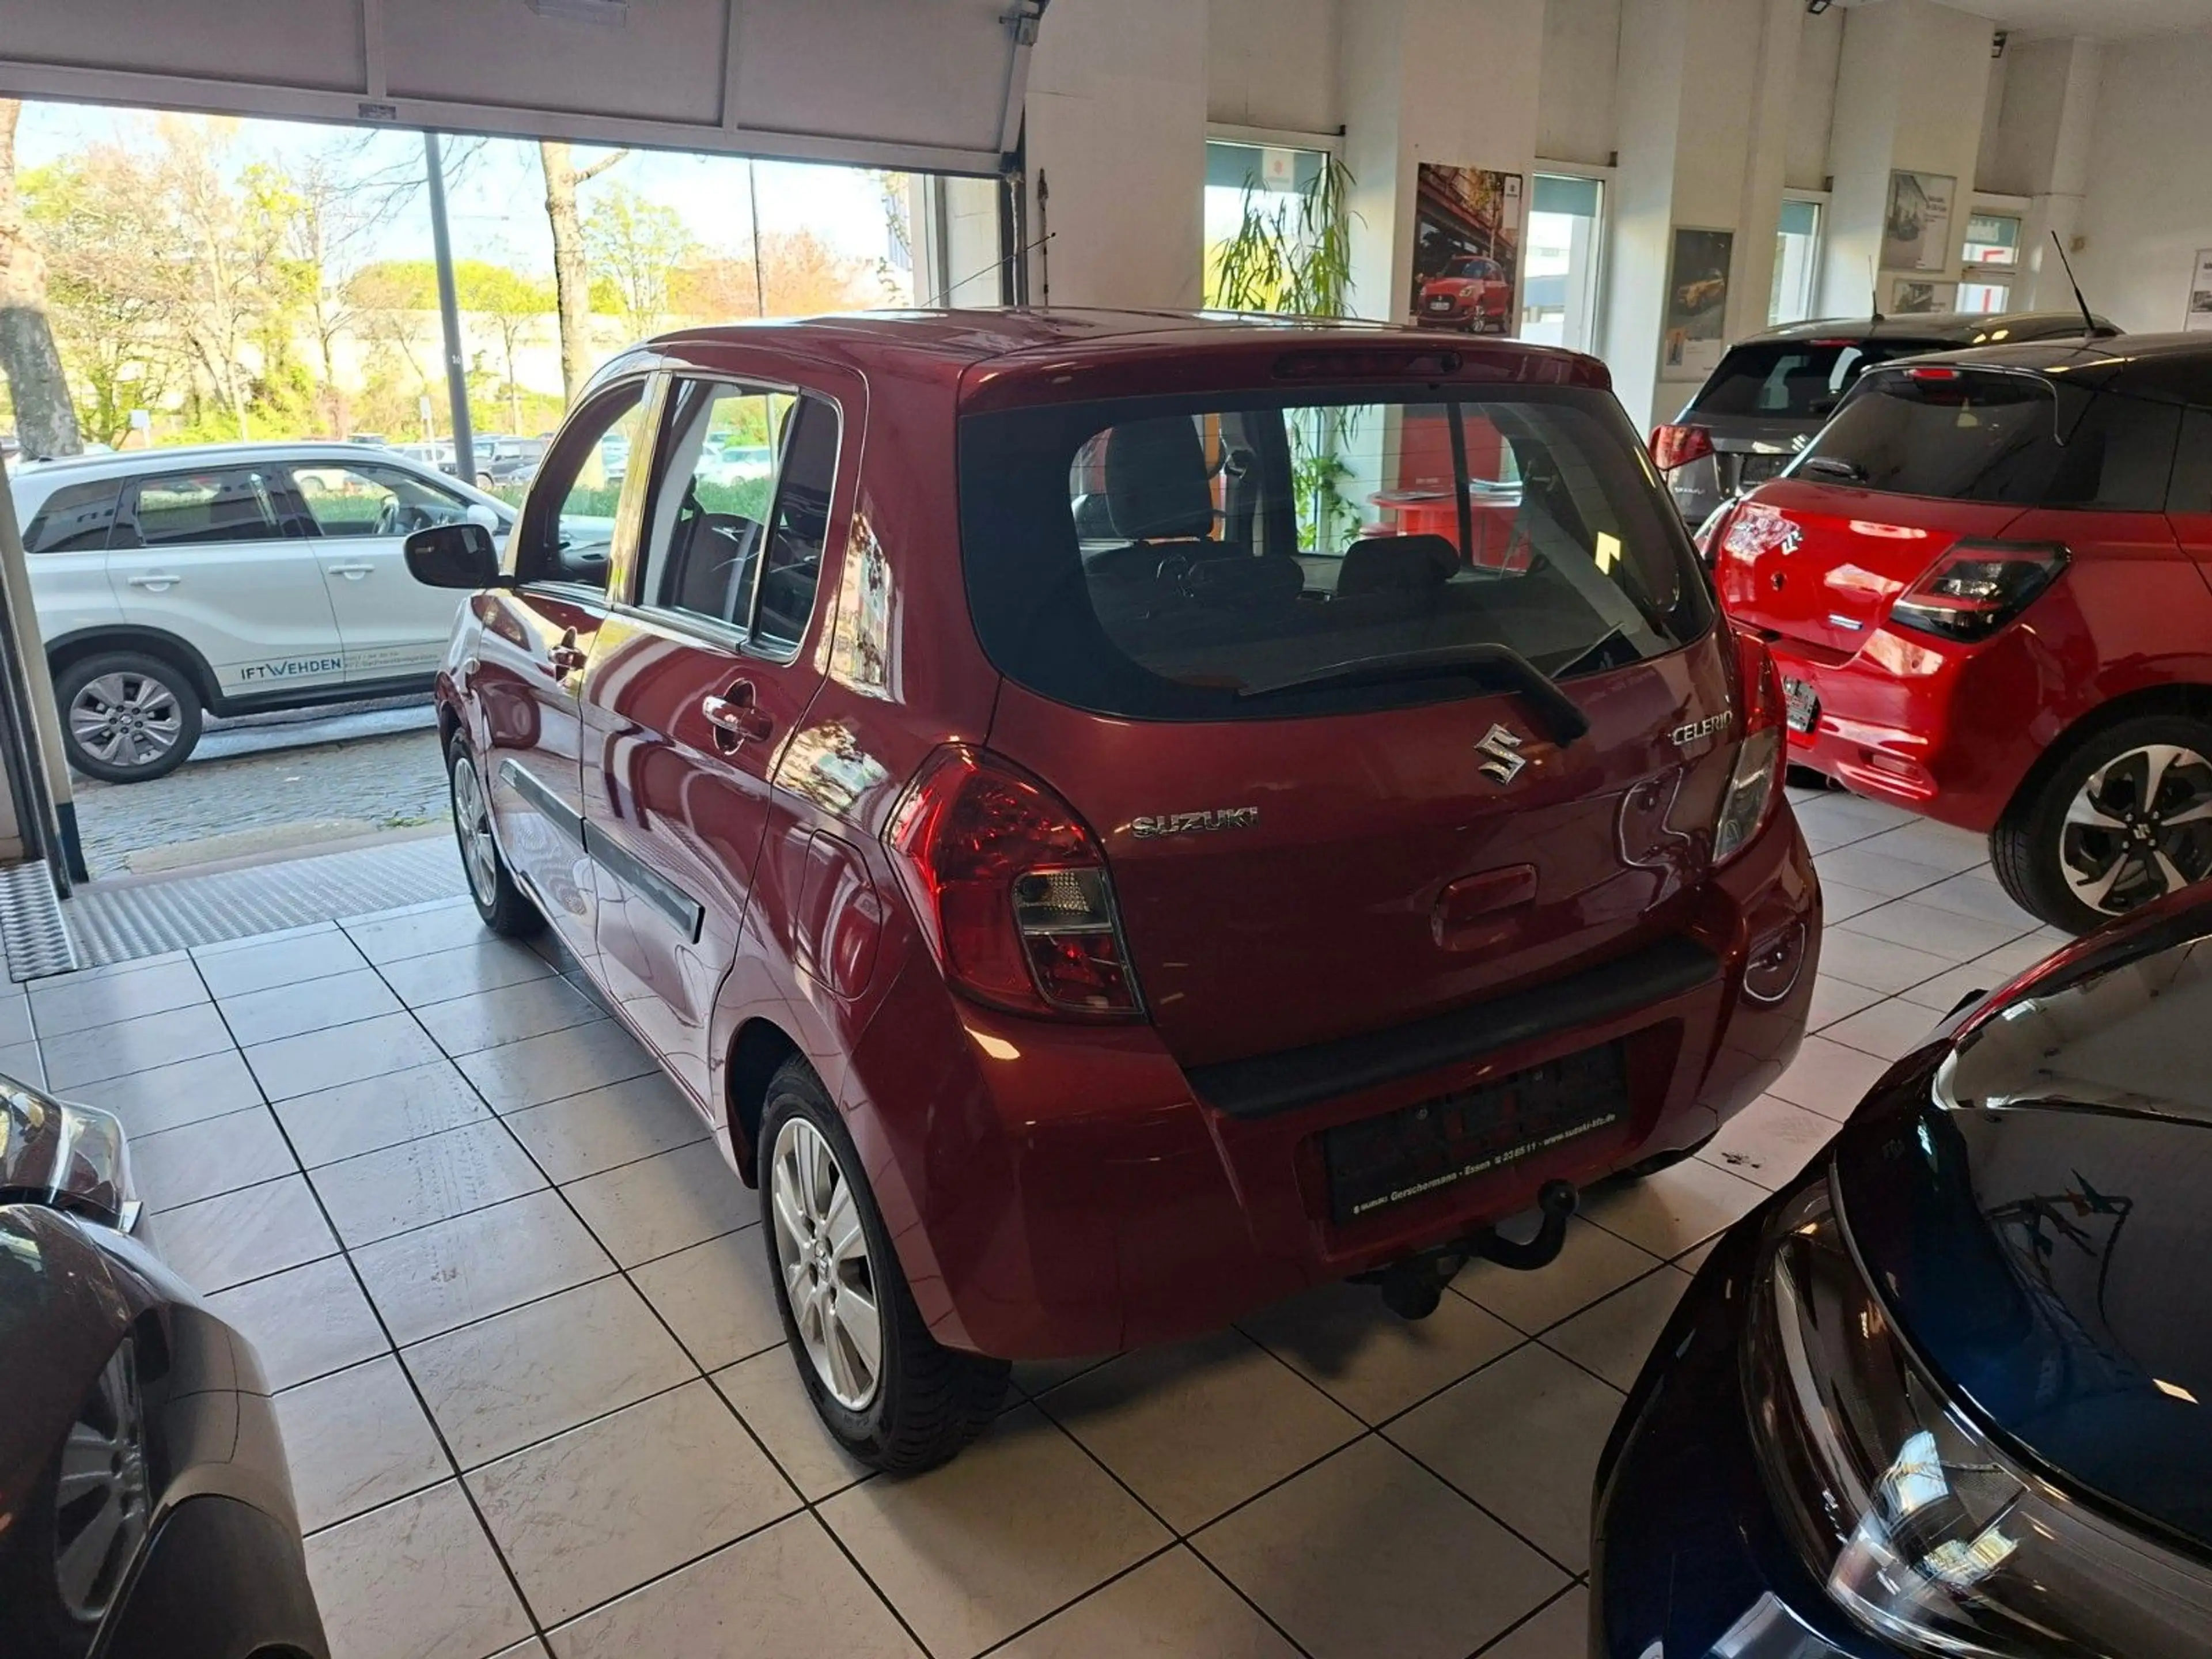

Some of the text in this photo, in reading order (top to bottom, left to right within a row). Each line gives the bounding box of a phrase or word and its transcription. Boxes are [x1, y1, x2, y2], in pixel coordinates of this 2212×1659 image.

[1672, 710, 1733, 746] CELERIO
[1131, 806, 1259, 838] SUZUKI
[1464, 1160, 1491, 1176] Essen
